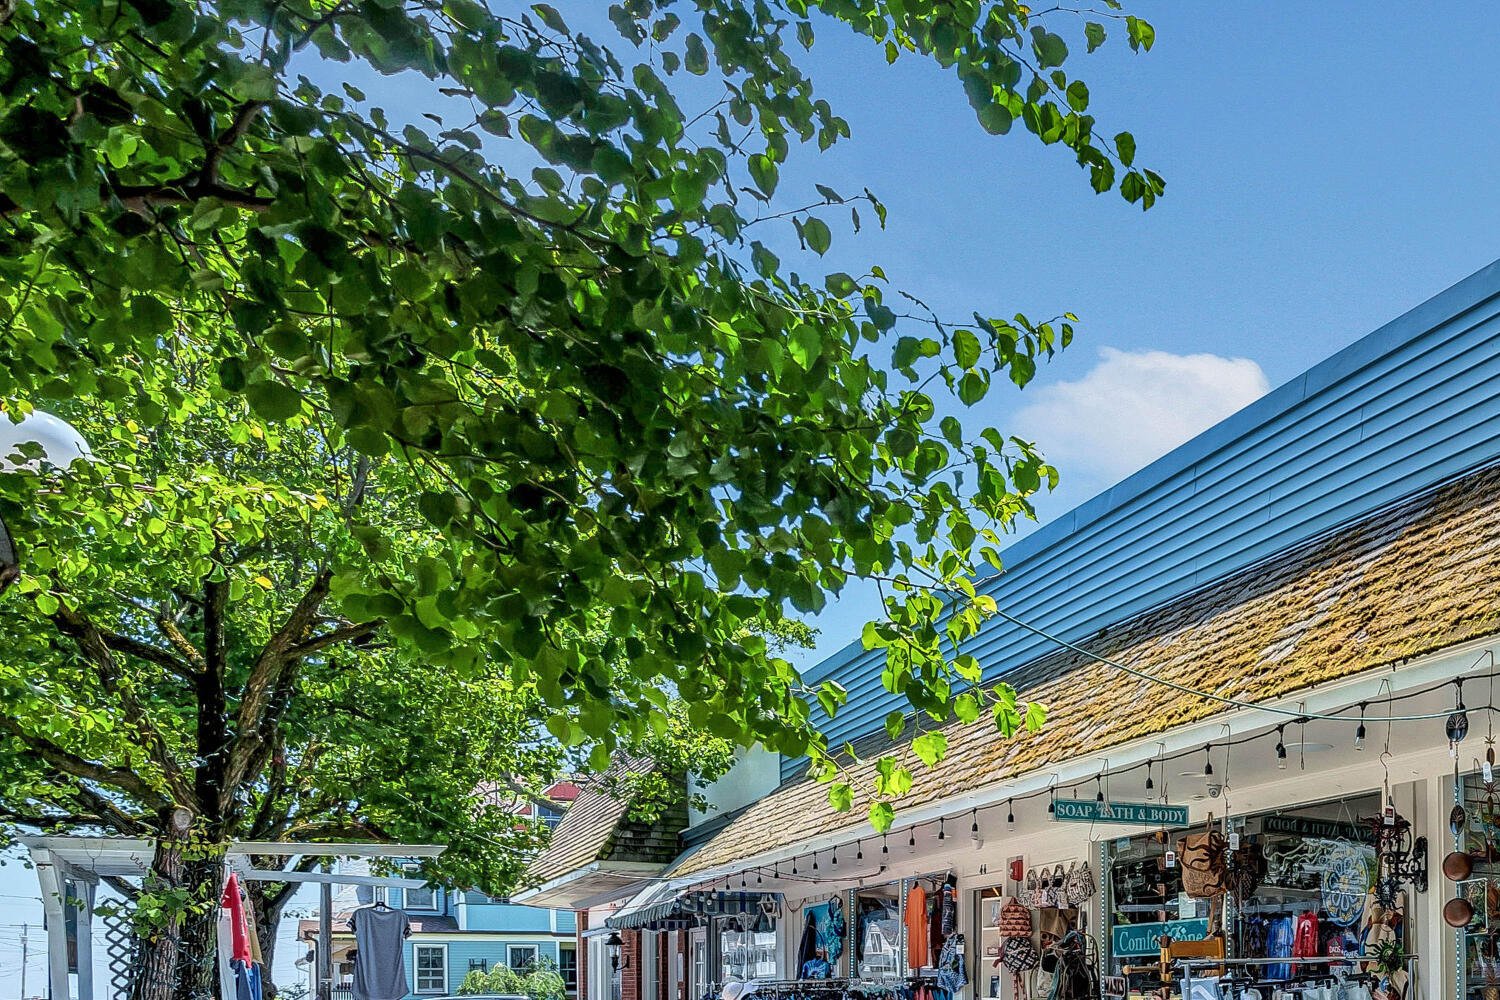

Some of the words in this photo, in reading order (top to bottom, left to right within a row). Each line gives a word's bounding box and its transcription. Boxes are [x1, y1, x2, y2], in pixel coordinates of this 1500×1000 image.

[1057, 803, 1093, 818] SOAP
[1138, 808, 1147, 820] &
[1151, 809, 1185, 822] BODY
[1119, 929, 1162, 952] Comfo
